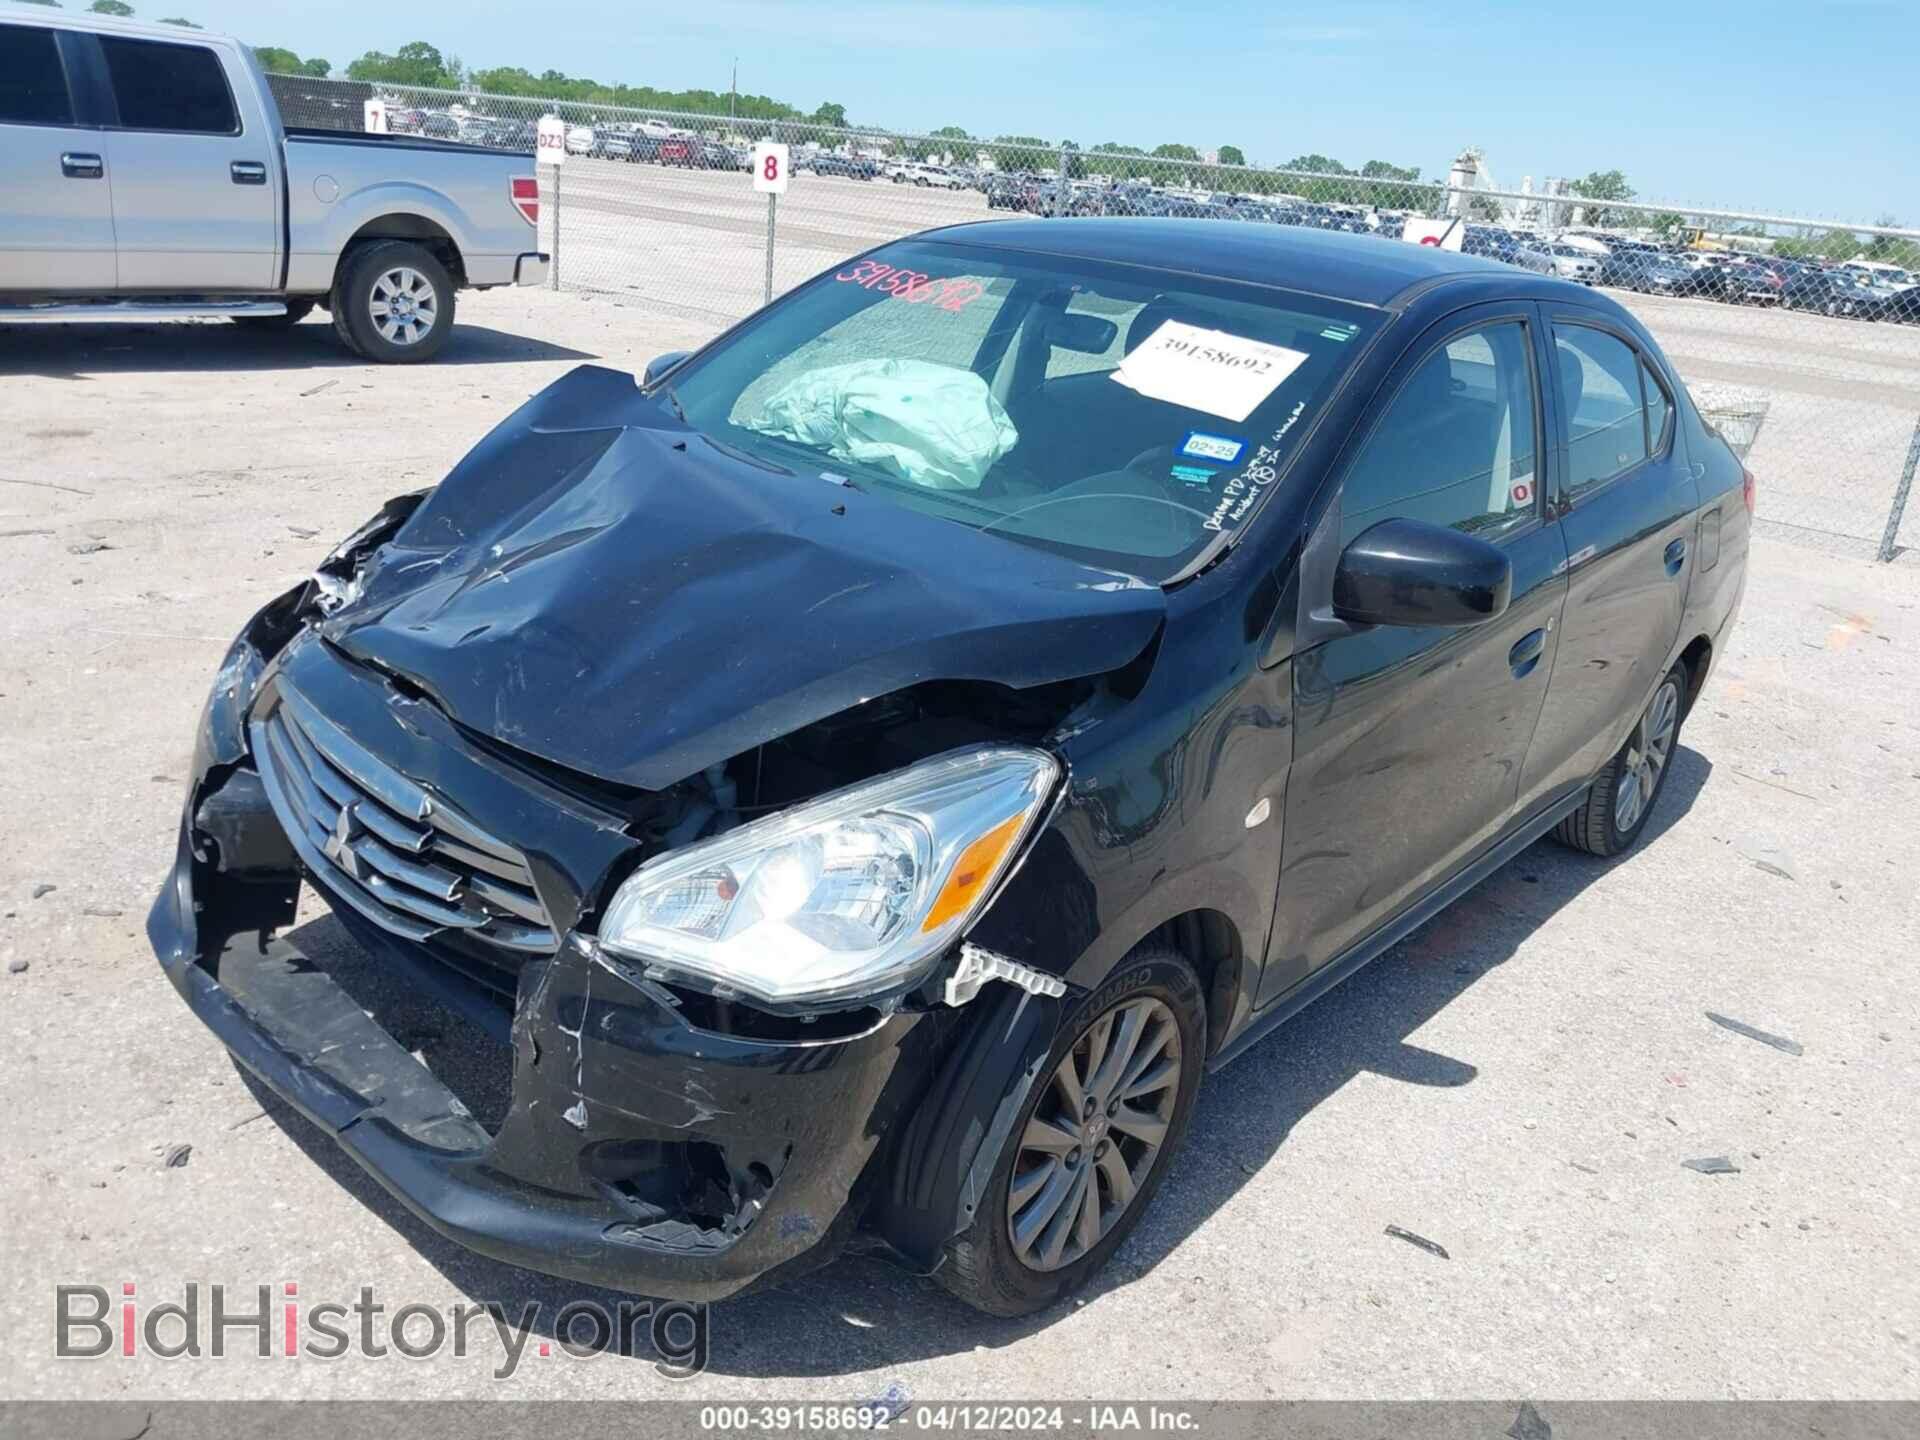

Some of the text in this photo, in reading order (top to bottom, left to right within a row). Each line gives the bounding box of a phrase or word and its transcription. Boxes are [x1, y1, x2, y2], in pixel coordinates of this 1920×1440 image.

[371, 110, 379, 131] 7
[764, 155, 777, 180] 8
[1154, 338, 1272, 375] 39158692
[1223, 478, 1245, 496] PD
